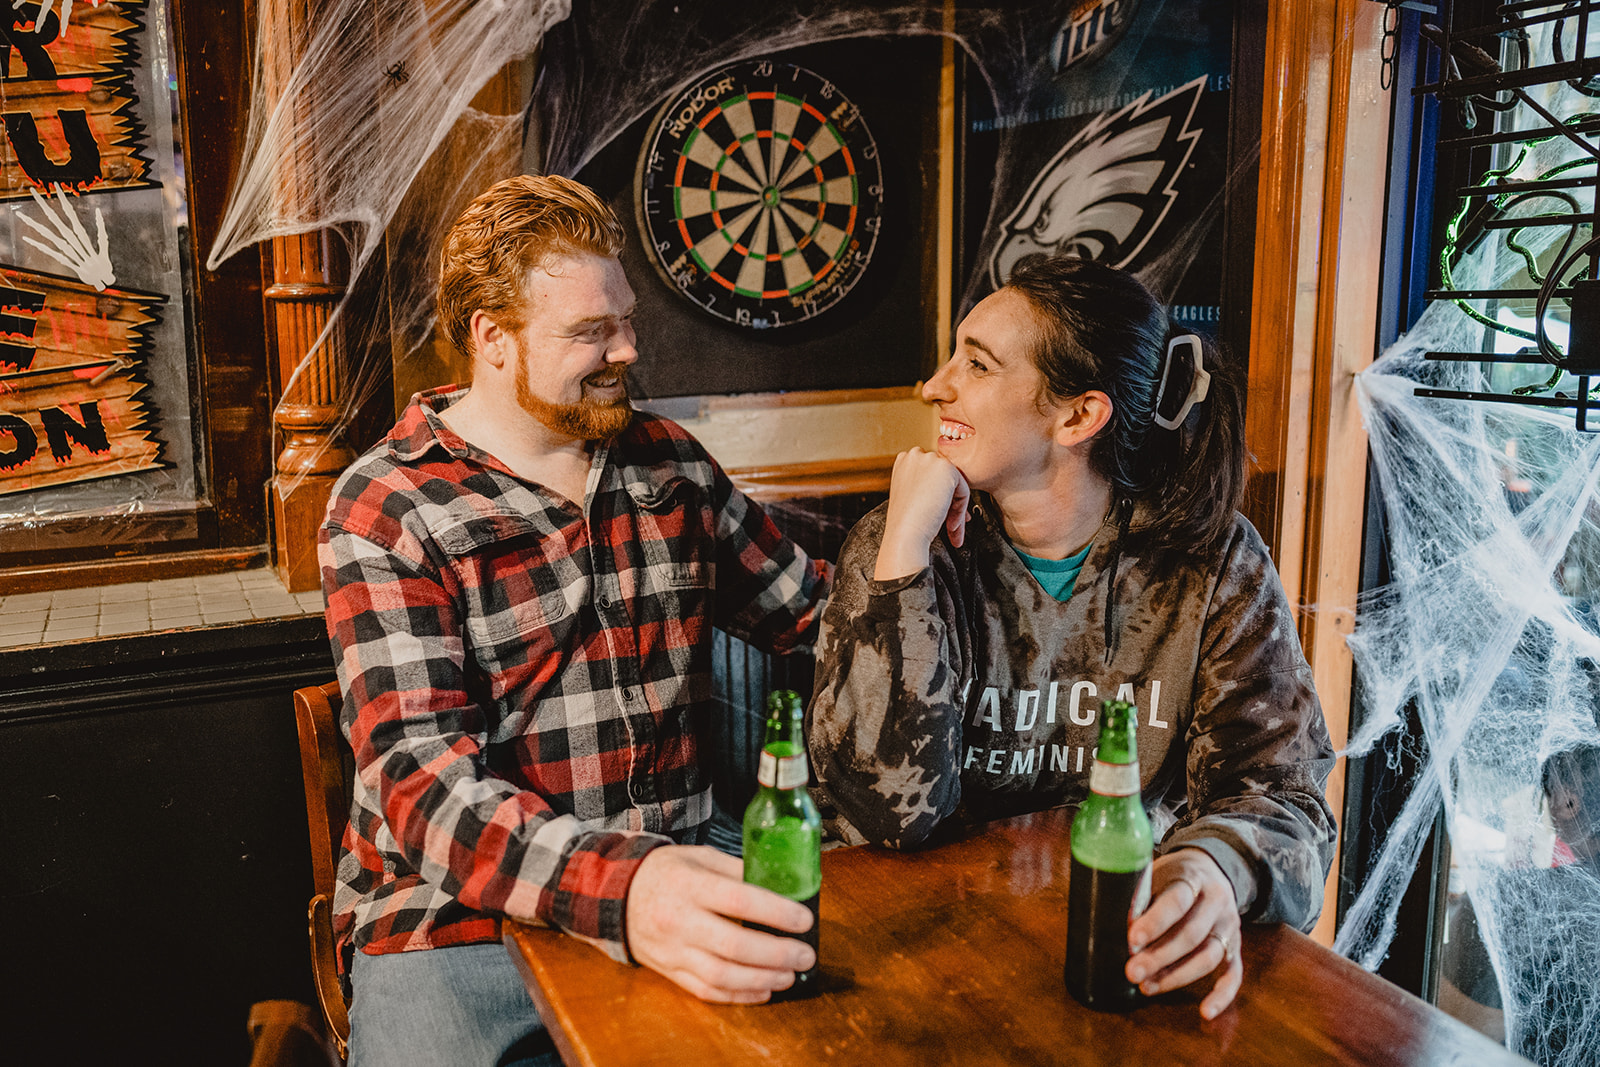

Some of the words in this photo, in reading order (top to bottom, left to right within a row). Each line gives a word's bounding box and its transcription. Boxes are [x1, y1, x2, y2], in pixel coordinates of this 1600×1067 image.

[669, 77, 735, 139] NODOR
[1173, 304, 1221, 322] EAGLES
[963, 678, 1169, 732] ADICAL
[963, 744, 1099, 775] FEMINI
